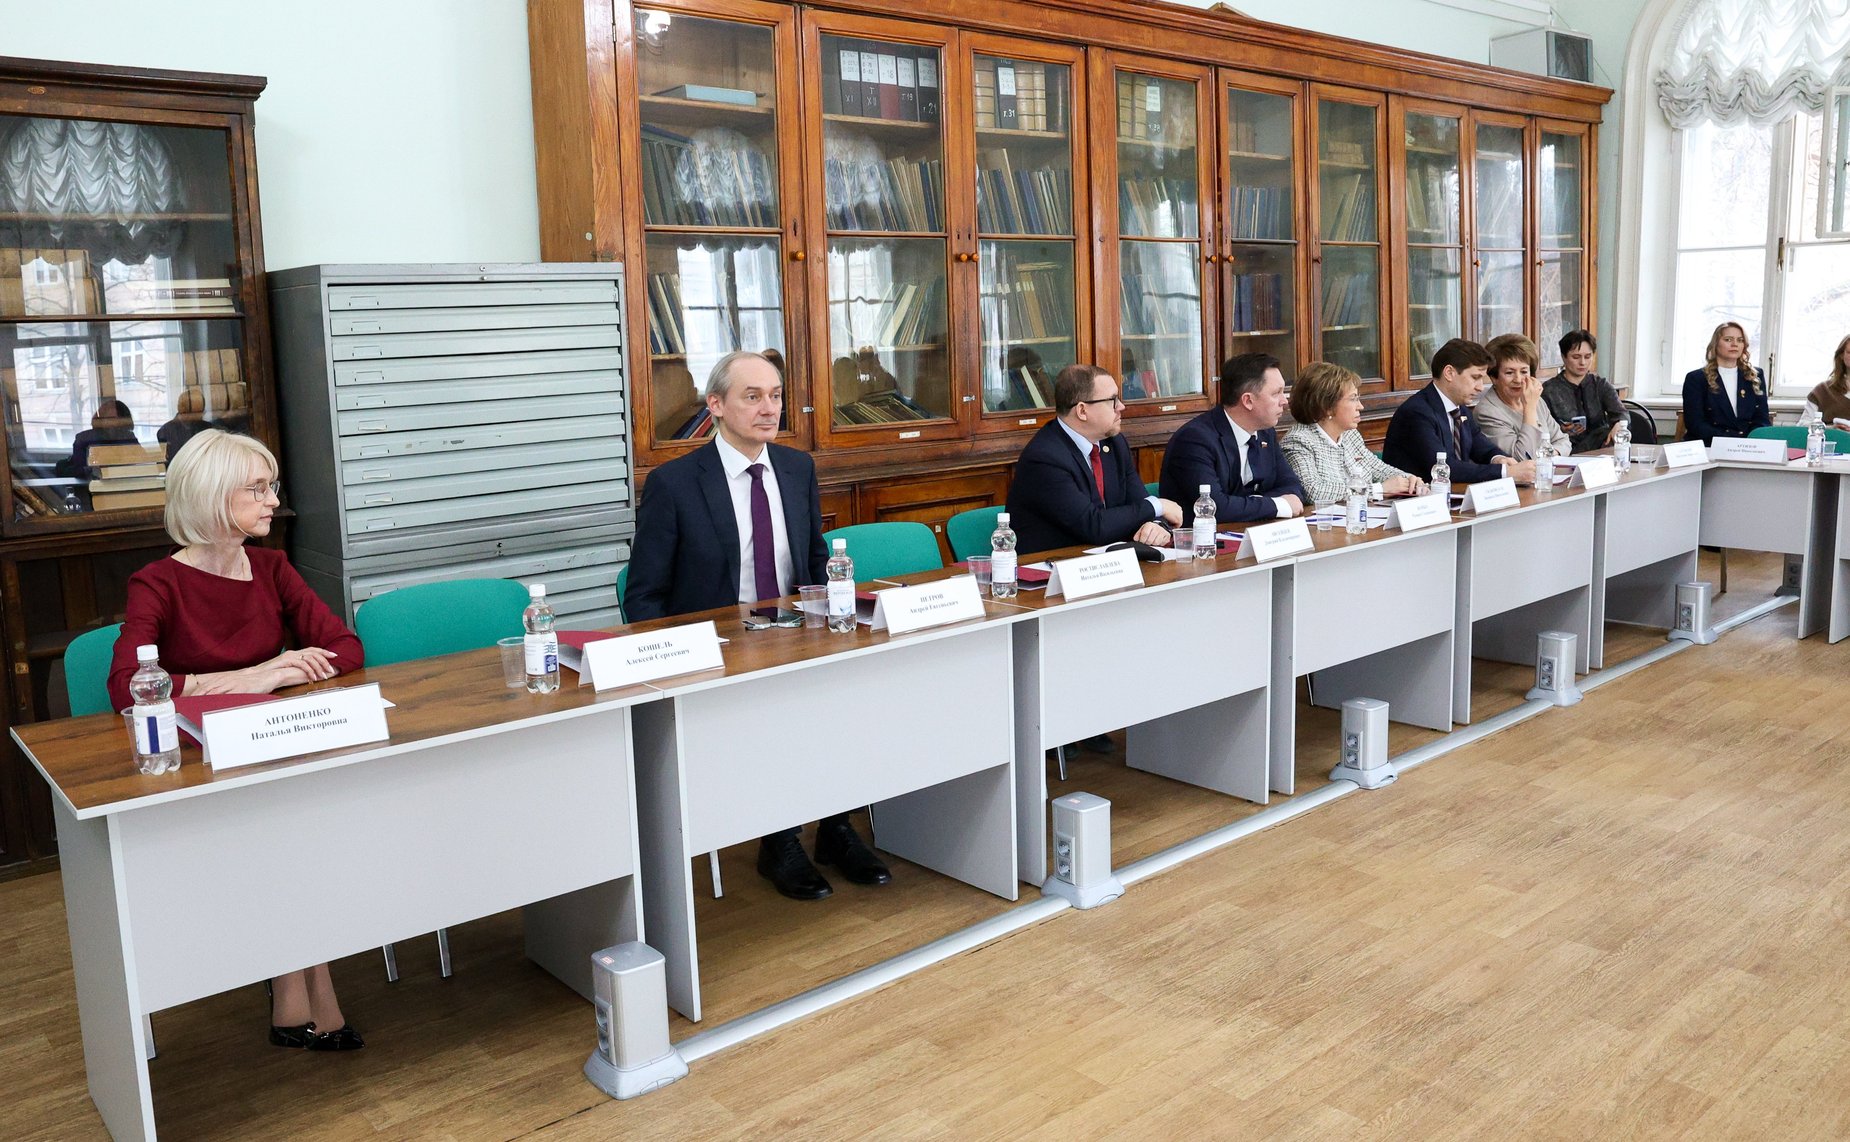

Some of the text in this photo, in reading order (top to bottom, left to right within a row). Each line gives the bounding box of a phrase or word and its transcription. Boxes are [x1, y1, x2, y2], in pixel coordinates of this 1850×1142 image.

[638, 641, 673, 653] КОШЕЛЬ
[626, 649, 690, 666] Алексей Сергеевич
[264, 707, 332, 726] АНТОНЕНКО
[250, 717, 348, 741] Наталья Викторовна
